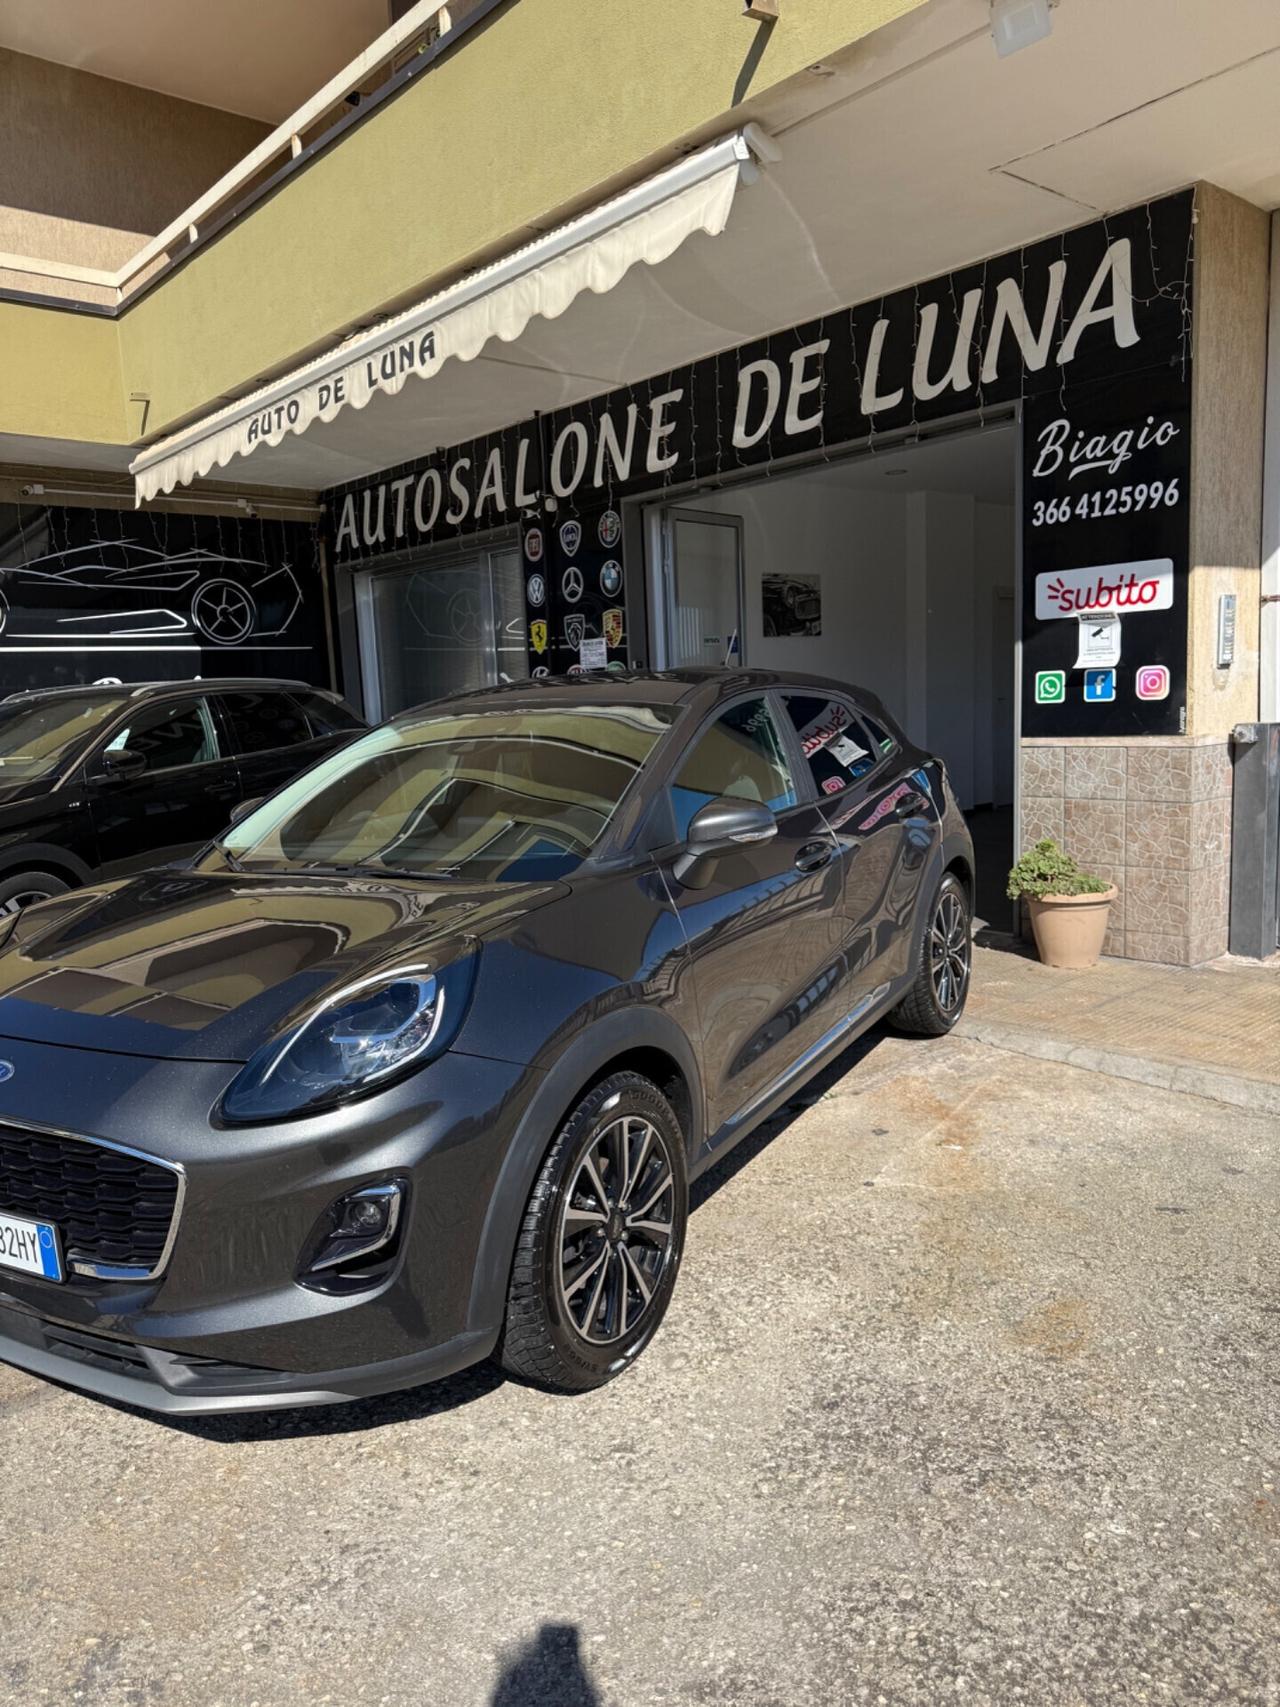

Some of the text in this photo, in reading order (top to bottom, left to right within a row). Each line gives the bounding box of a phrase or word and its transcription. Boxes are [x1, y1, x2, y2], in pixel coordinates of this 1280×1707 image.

[247, 330, 436, 444] AUTO DE LUNA
[335, 238, 1141, 552] AUTOSALONE DE LUNA
[1032, 416, 1180, 480] Biagio
[1032, 478, 1179, 526] 366 4125996
[1058, 573, 1160, 612] subito
